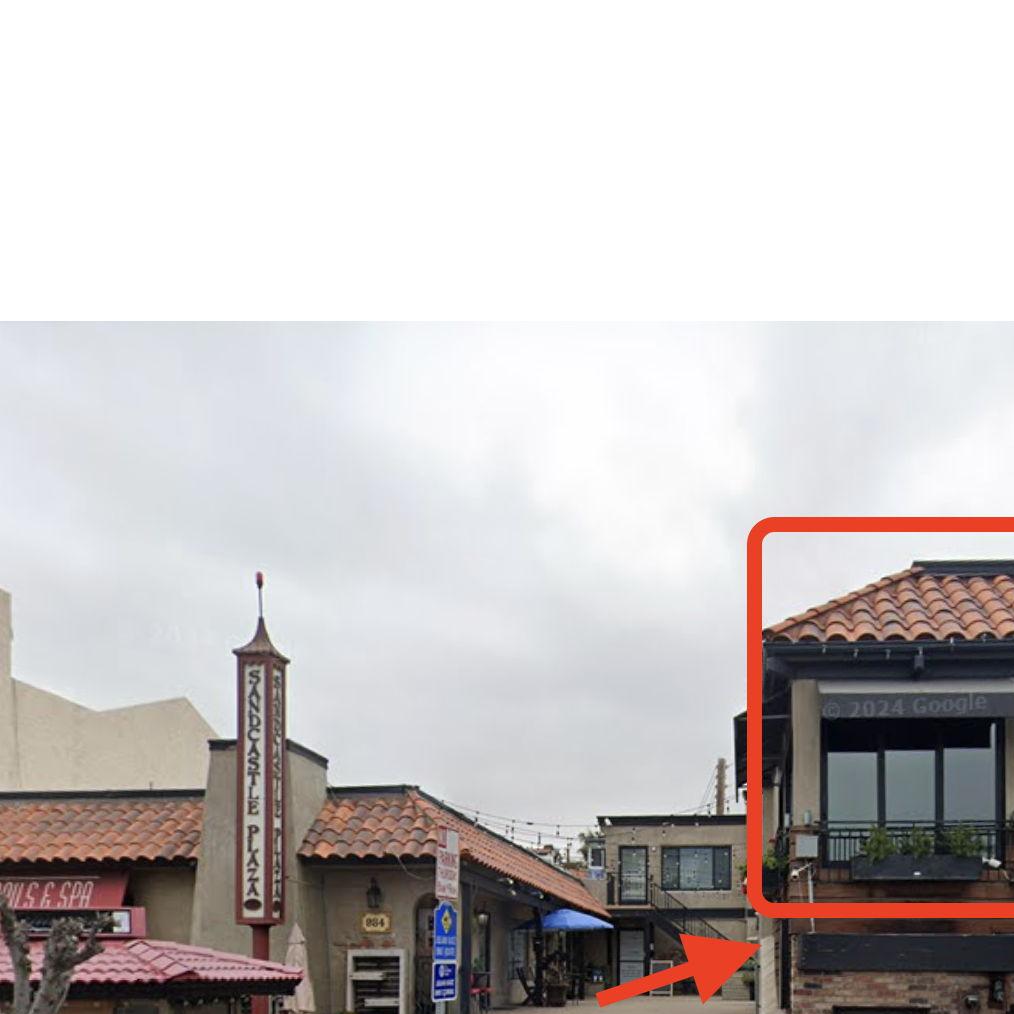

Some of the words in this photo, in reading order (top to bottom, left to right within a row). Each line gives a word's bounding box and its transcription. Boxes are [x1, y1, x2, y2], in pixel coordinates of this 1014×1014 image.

[246, 669, 262, 816] SANDCASTLE
[58, 881, 94, 908] SPA
[246, 826, 260, 897] PLAZA
